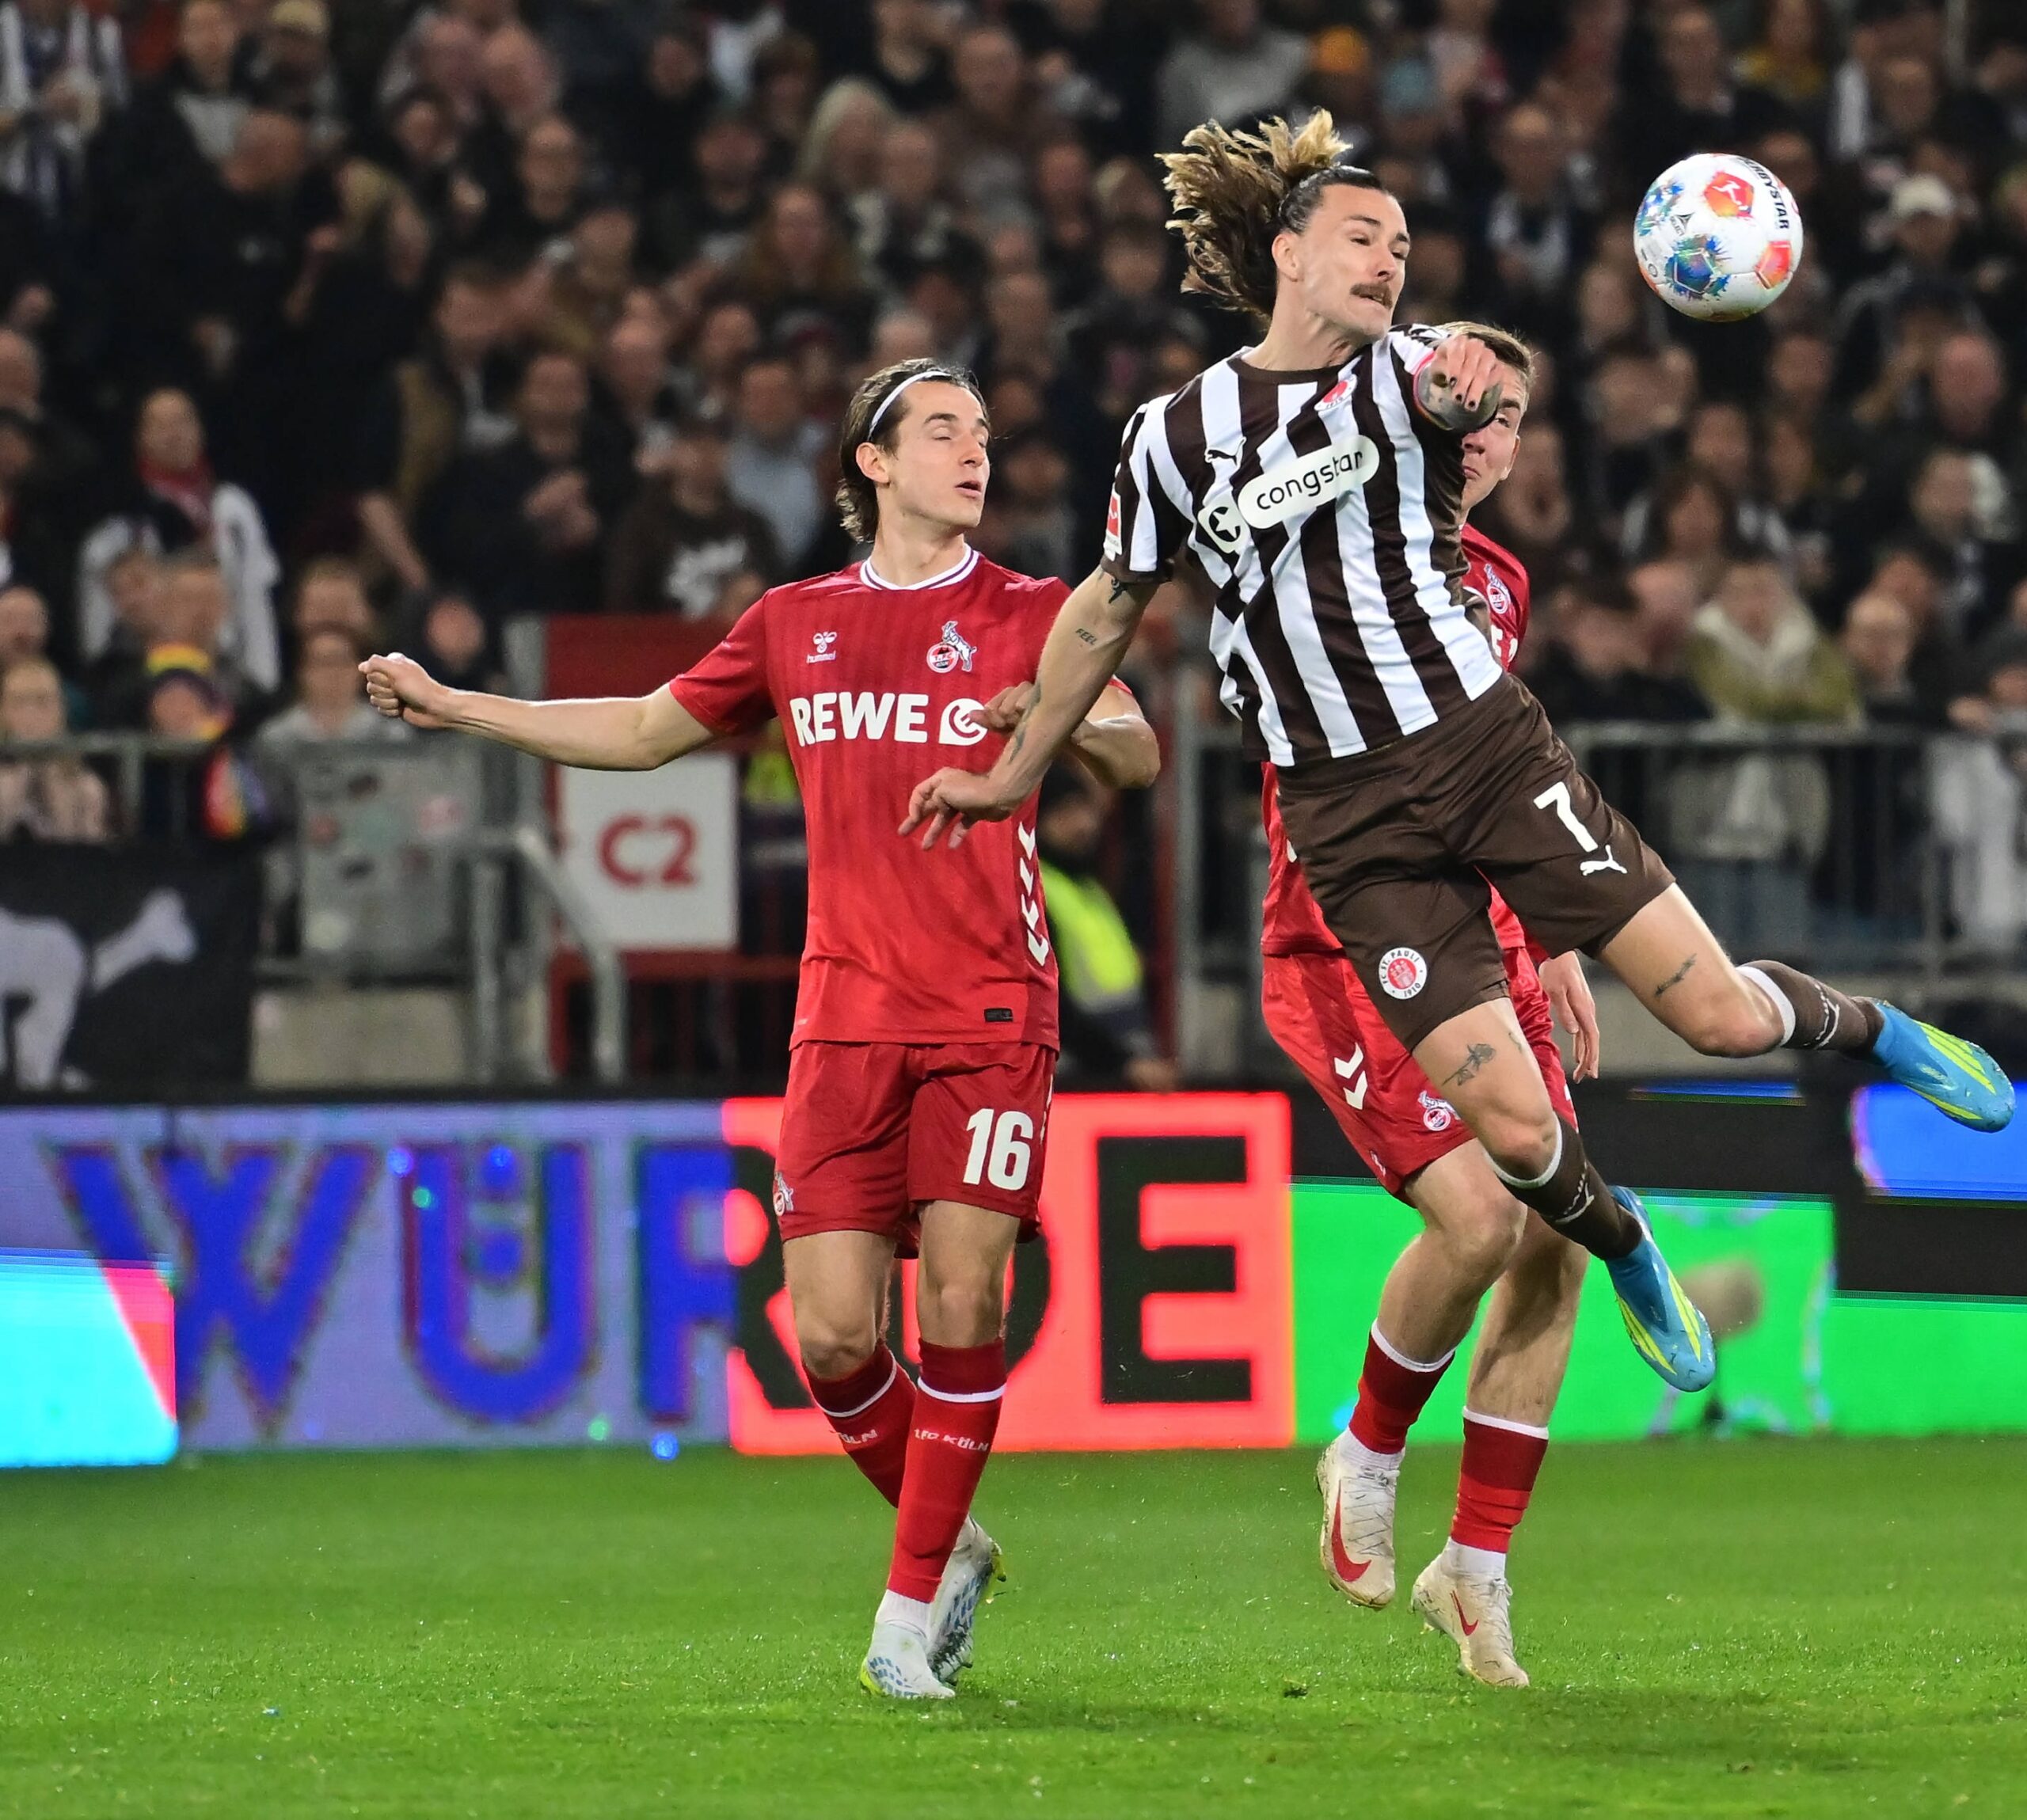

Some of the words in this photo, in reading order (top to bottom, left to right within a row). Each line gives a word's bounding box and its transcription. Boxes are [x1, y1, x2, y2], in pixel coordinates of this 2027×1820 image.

[1256, 450, 1363, 510] congstar
[806, 650, 836, 663] hummel
[789, 691, 929, 747] REWE
[1533, 781, 1599, 853] 7
[597, 814, 699, 887] C2
[1390, 949, 1420, 963] PAULI
[1403, 982, 1421, 997] 1910
[963, 1108, 1033, 1191] 16
